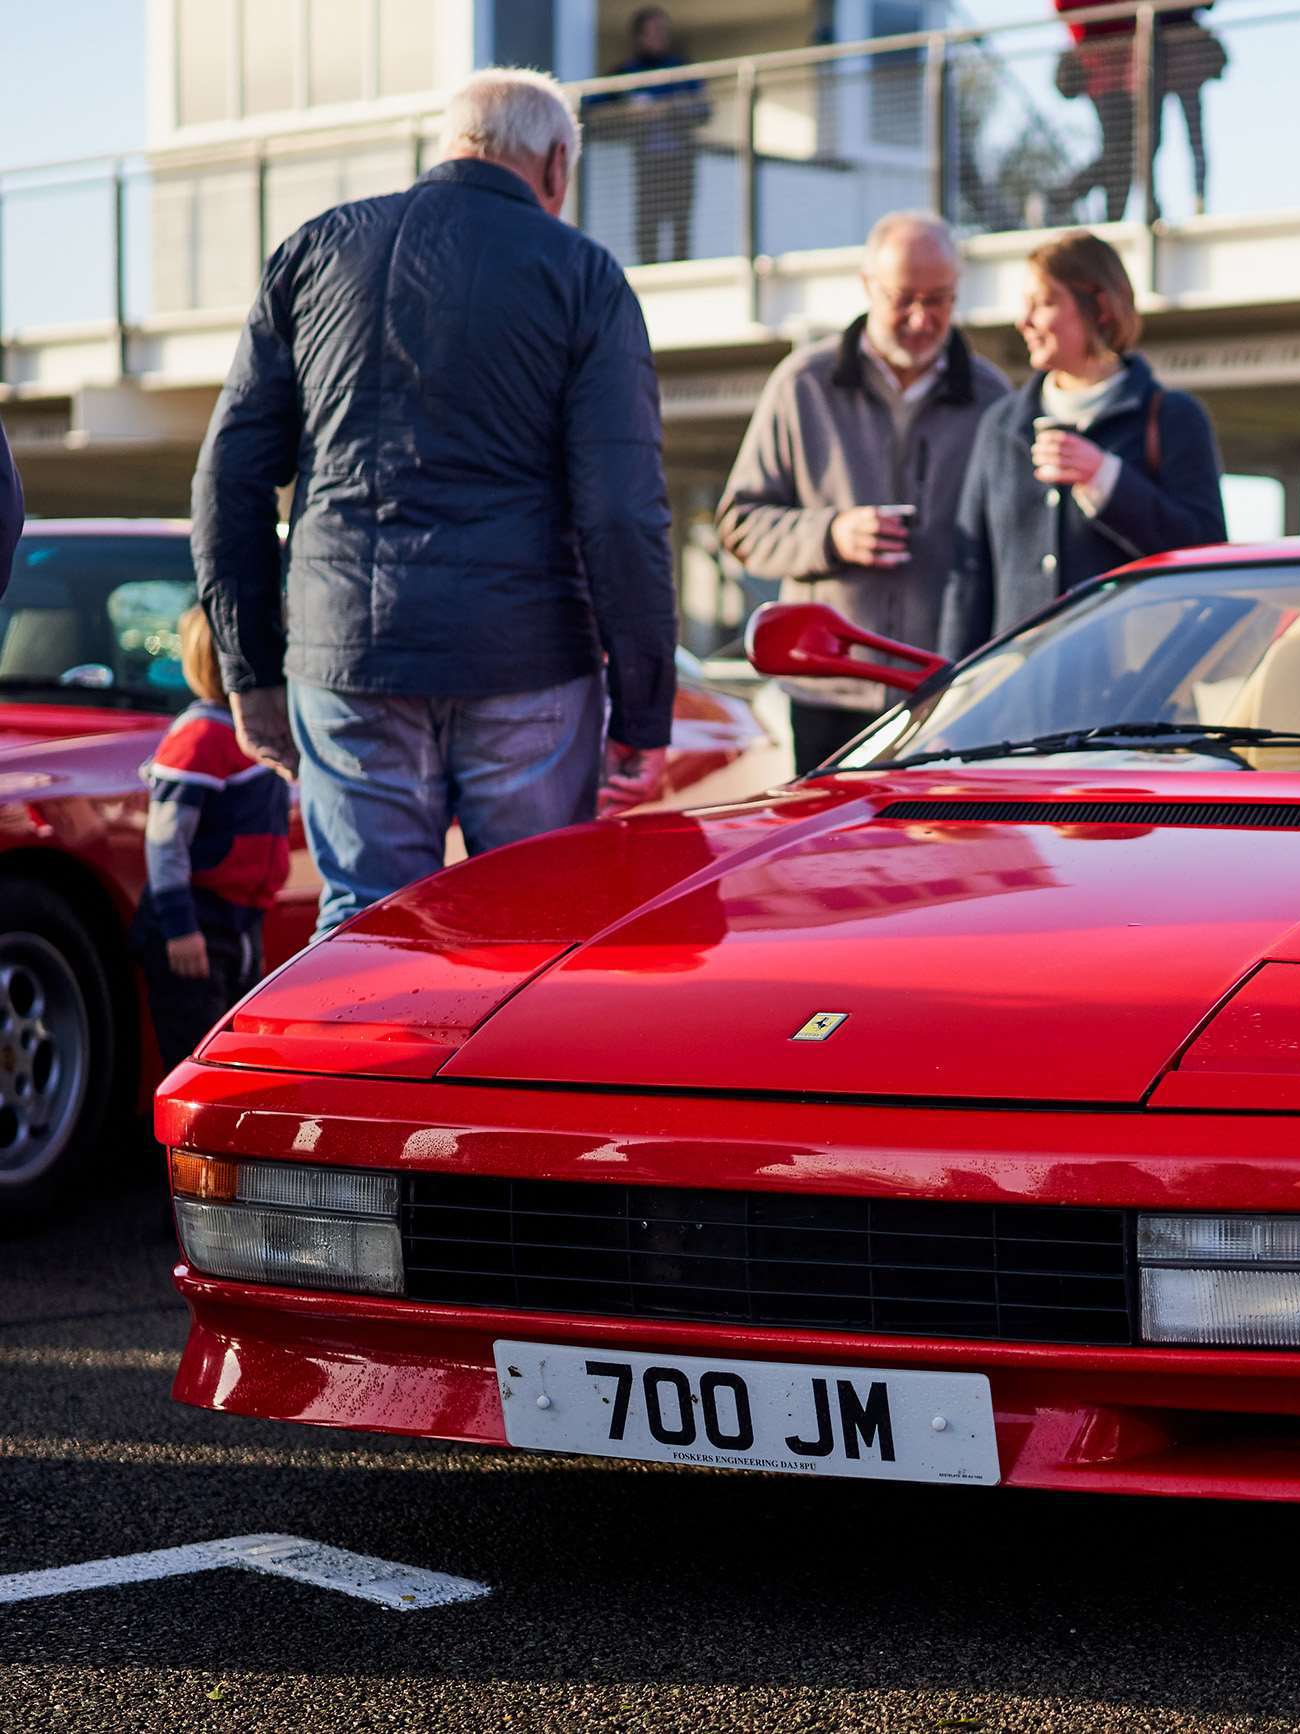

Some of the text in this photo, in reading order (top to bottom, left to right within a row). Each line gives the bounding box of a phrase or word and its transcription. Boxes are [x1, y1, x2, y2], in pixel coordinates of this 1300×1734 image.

[585, 1360, 896, 1461] 700 JM
[673, 1451, 714, 1463] FOSKERS
[715, 1455, 779, 1468] ENGINEERING
